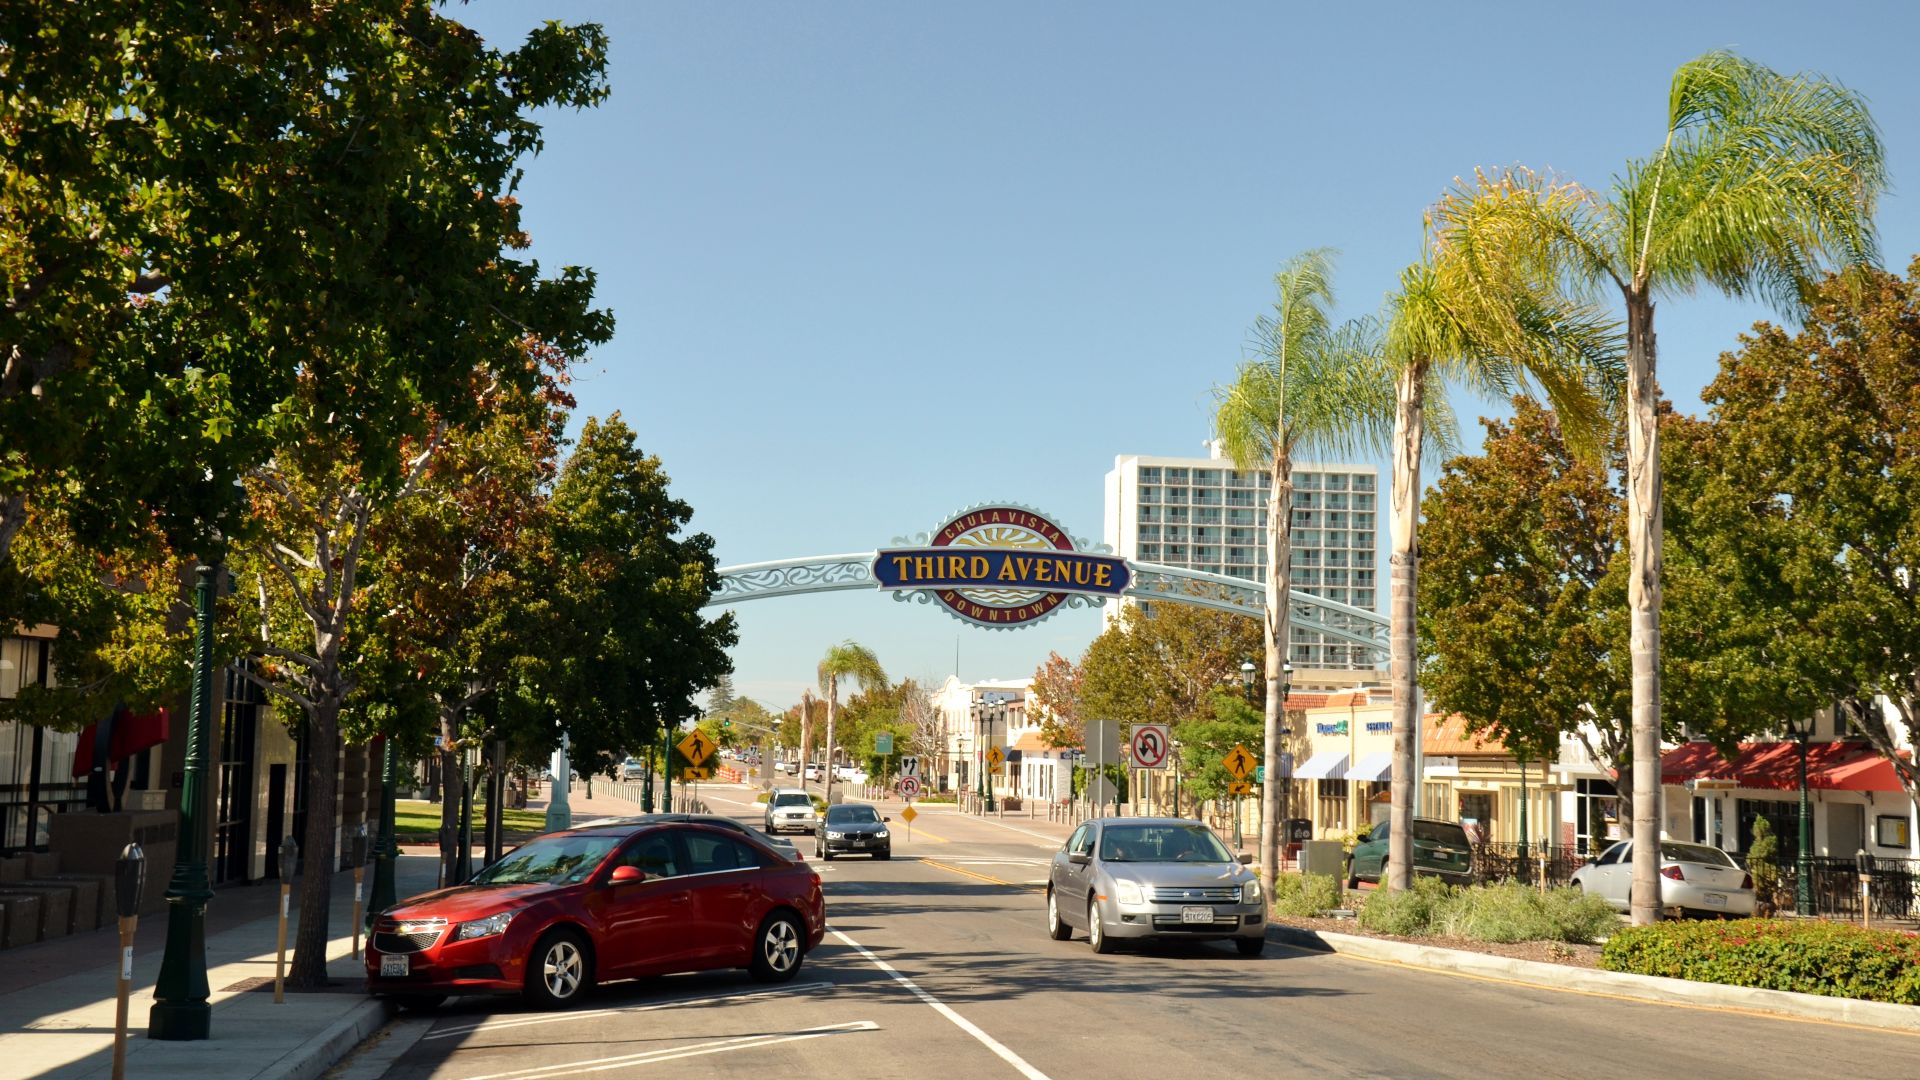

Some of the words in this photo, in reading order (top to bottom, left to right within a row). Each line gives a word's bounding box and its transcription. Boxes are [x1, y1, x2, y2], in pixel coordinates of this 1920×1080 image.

[945, 511, 1000, 540] CHULA
[1008, 512, 1060, 543] VISTA
[893, 555, 990, 581] THIRD
[997, 554, 1112, 587] AVENUE
[944, 592, 1059, 622] DOWNTOWN
